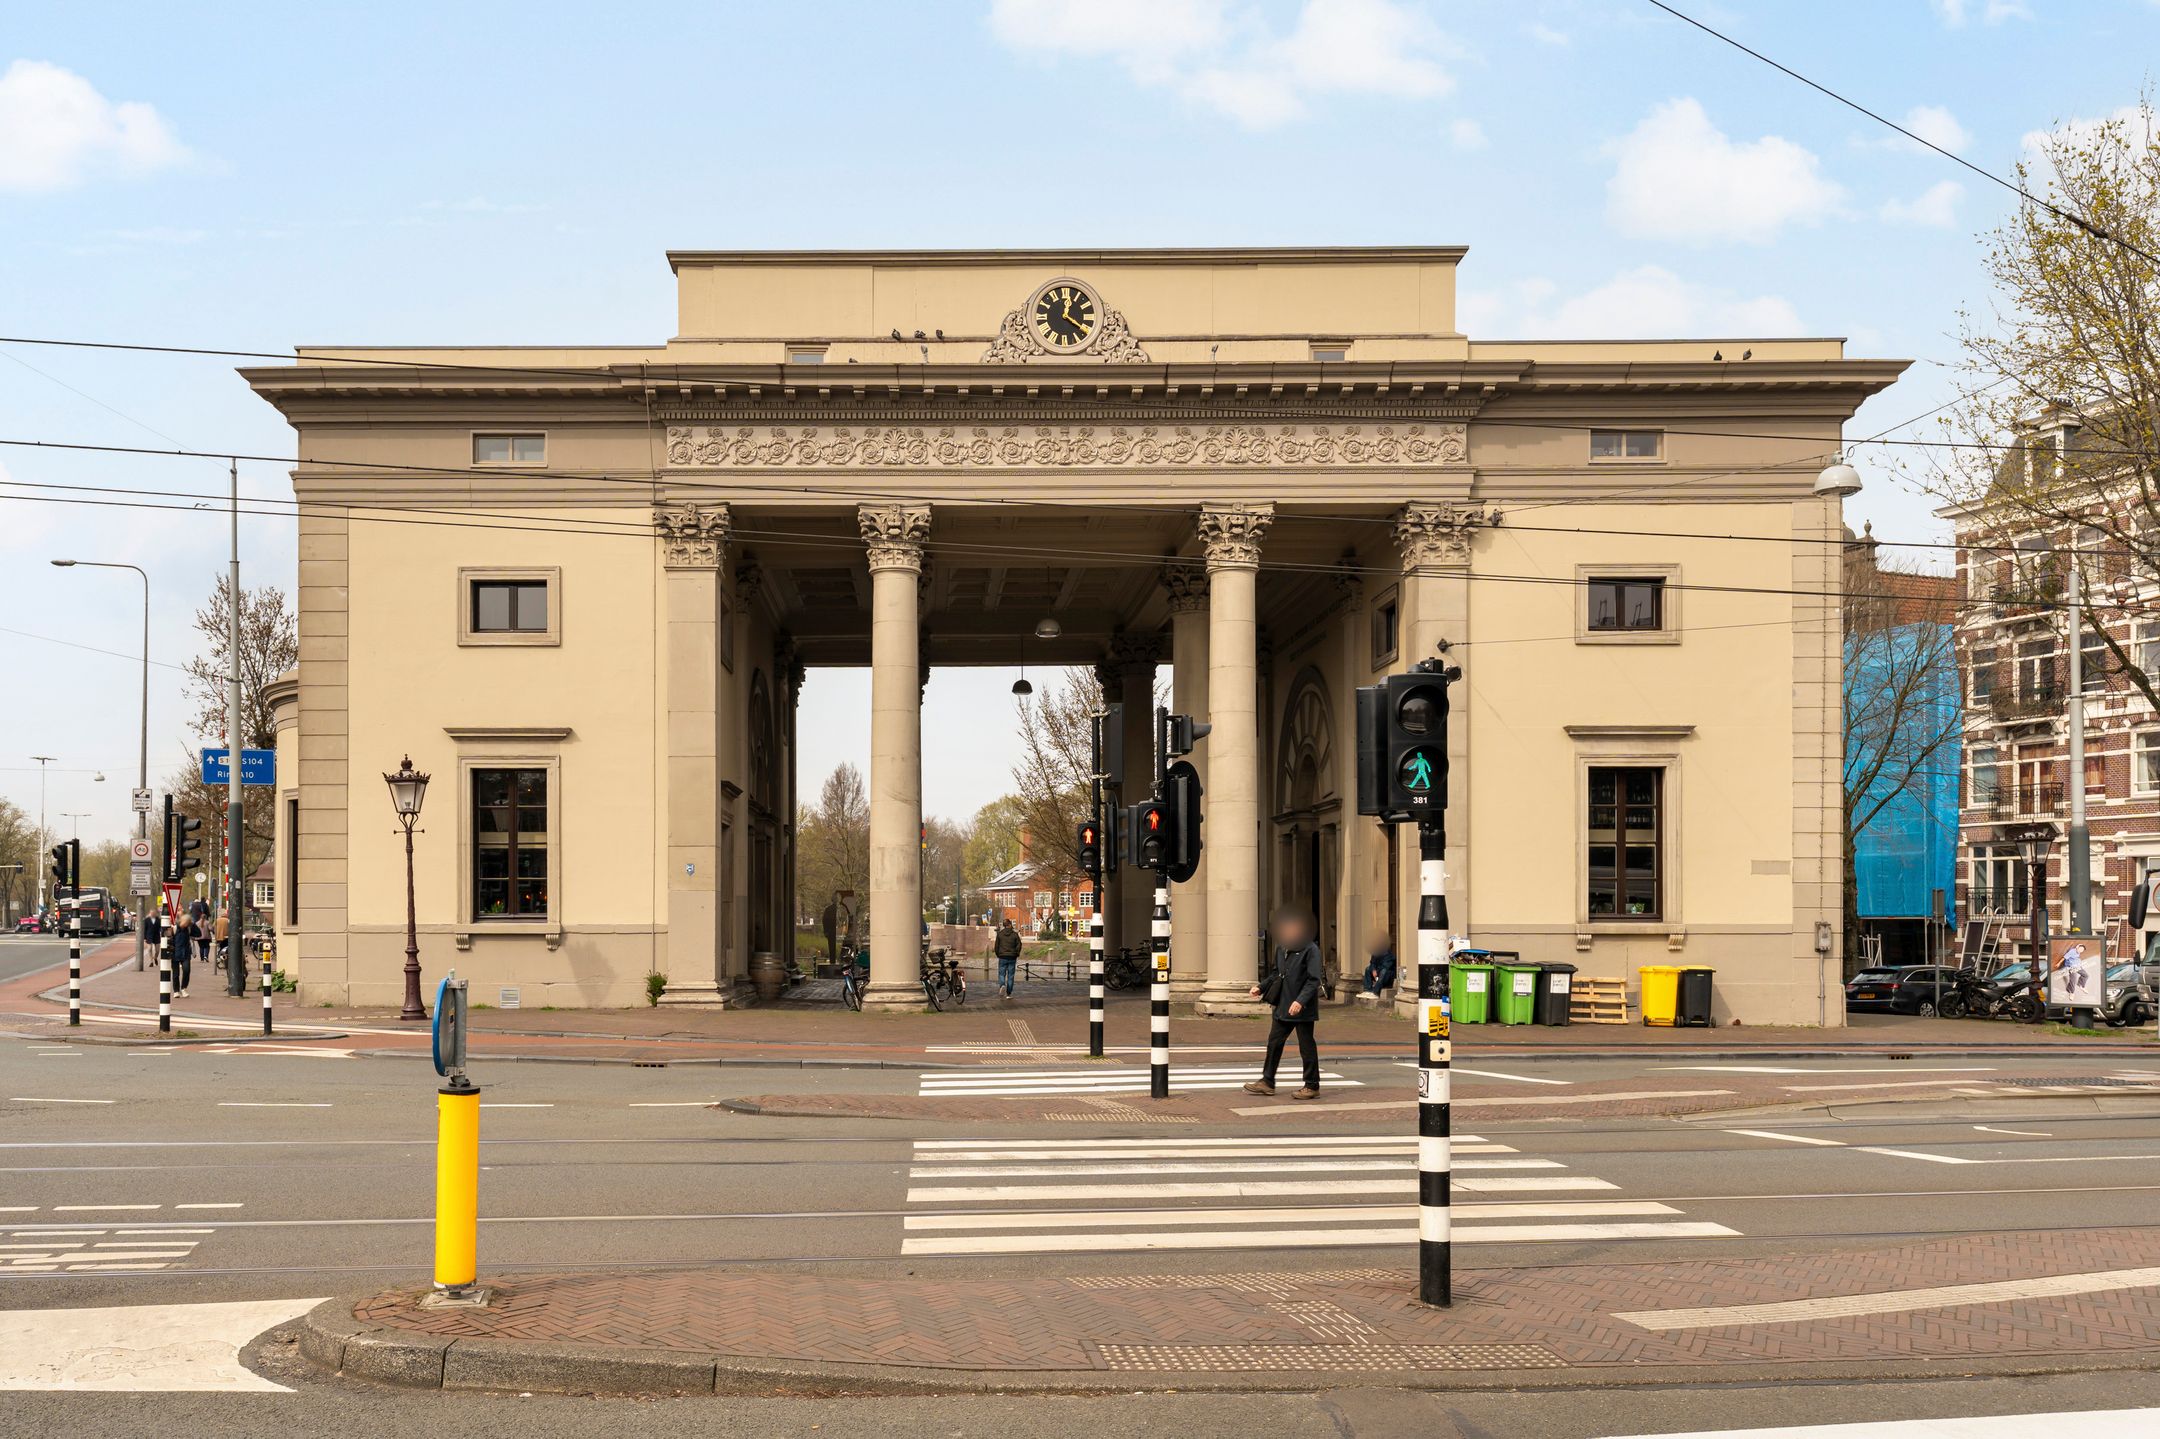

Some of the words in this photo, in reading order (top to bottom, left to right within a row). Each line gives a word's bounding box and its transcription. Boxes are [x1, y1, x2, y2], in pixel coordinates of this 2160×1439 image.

[242, 757, 263, 765] S104
[217, 770, 230, 778] Rin
[1412, 796, 1428, 804] 381
